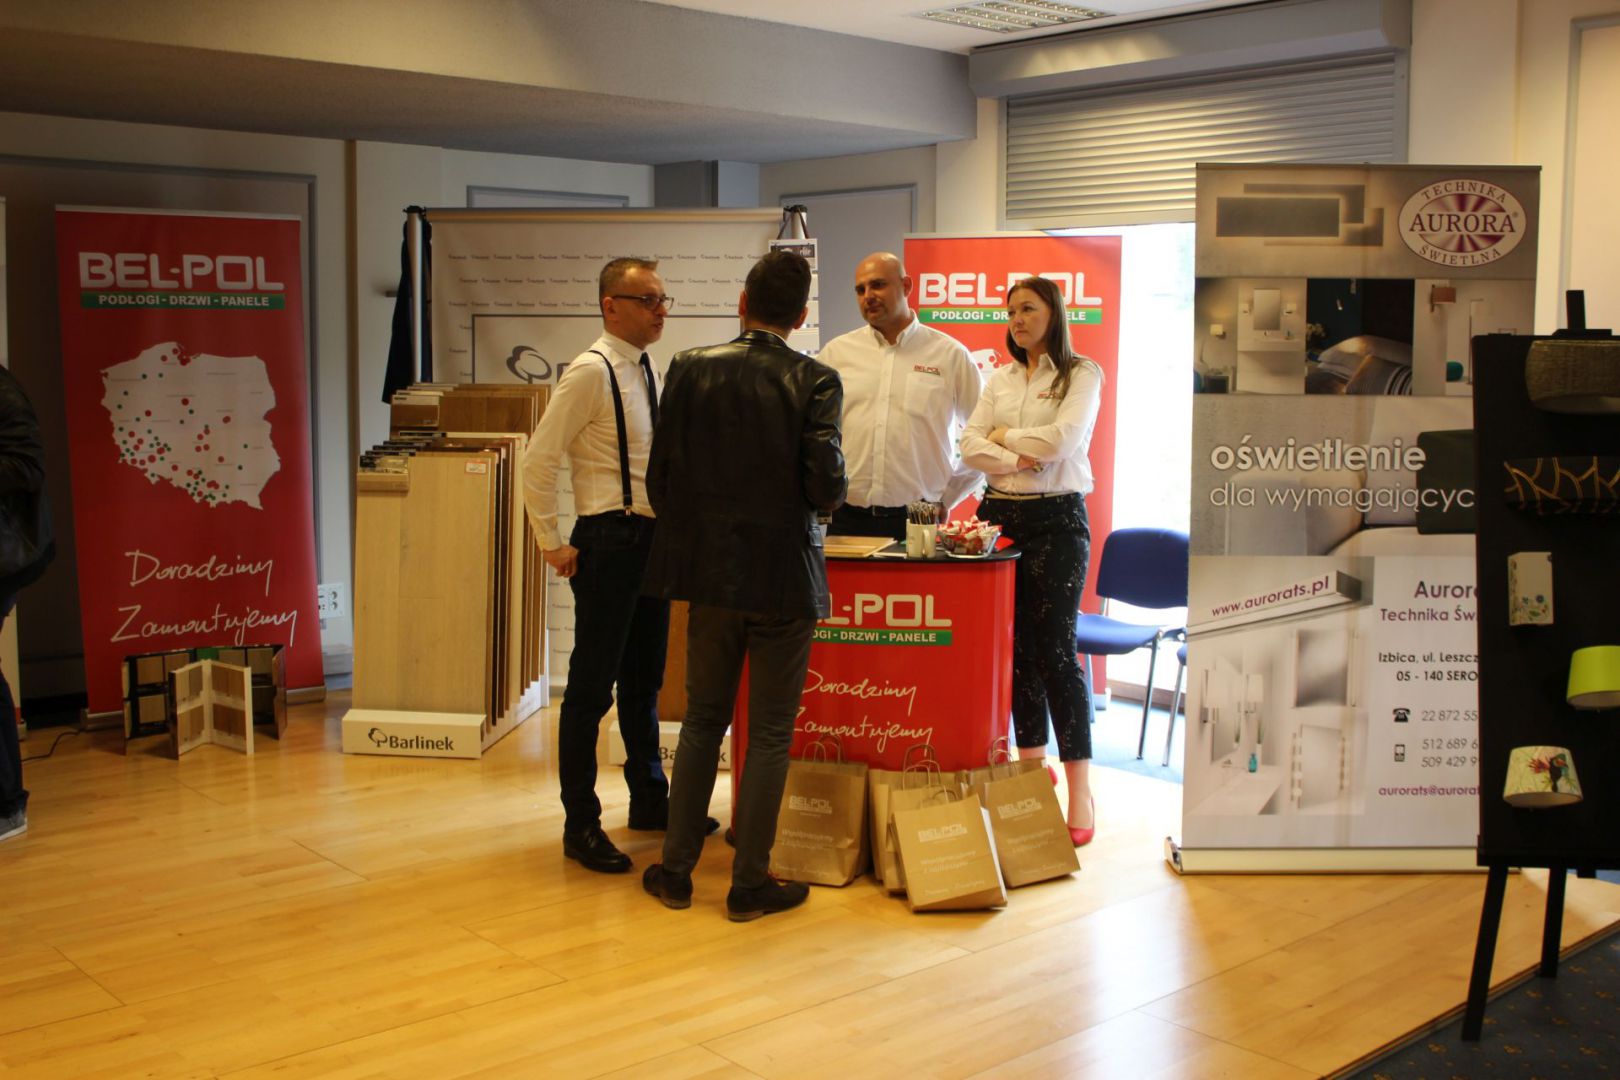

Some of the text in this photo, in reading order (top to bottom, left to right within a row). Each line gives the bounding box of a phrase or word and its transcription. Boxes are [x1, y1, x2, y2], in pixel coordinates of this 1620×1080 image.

[1421, 181, 1507, 203] TECHNIKA
[1409, 213, 1516, 233] AURORA
[1420, 243, 1502, 265] ŚWIETLNA
[78, 251, 285, 291] BEL-POL
[99, 294, 160, 305] PODŁOGI
[169, 295, 211, 306] DRZWI
[221, 296, 270, 307] PANELE
[932, 310, 984, 321] PODŁOGI
[1210, 434, 1427, 471] oświetlenie
[1209, 482, 1476, 513] dla wymagającyc
[124, 549, 273, 597] Doradzimy
[1212, 575, 1329, 617] www.aurorats.pl
[817, 592, 953, 627] L-POL
[1380, 608, 1449, 621] Technika
[110, 603, 298, 648] Zamontujemy
[840, 631, 879, 641] DRZWI
[889, 632, 937, 643] PANELE
[1440, 652, 1479, 663] Leszcz
[1396, 671, 1411, 682] 05
[1424, 671, 1444, 681] 140
[1446, 670, 1479, 681] SERO
[1421, 710, 1436, 721] 22
[1438, 710, 1460, 721] 872
[389, 735, 455, 751] Barlinek
[1422, 739, 1443, 750] 512
[1446, 738, 1468, 750] 689
[1421, 757, 1442, 768] 509
[1446, 756, 1467, 767] 429
[1378, 785, 1480, 796] aurorats@aurorat
